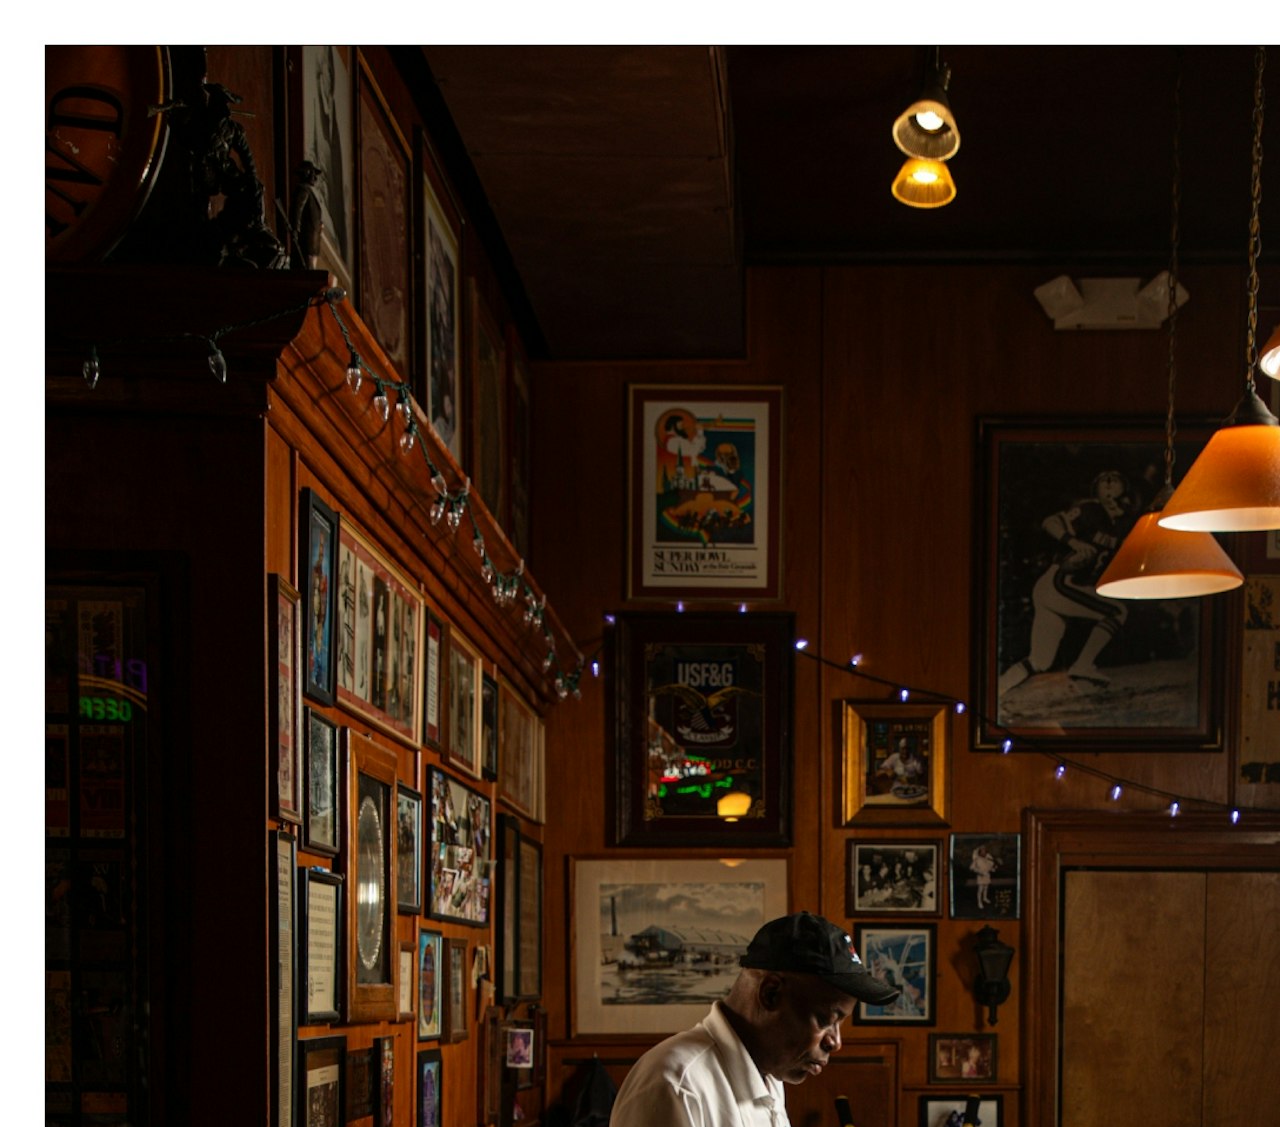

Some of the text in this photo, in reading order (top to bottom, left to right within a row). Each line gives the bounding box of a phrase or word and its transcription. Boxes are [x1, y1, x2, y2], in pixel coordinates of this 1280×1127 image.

[653, 550, 731, 562] SUPER BOWL
[653, 562, 700, 573] SUNDAY
[677, 662, 733, 687] USF&G
